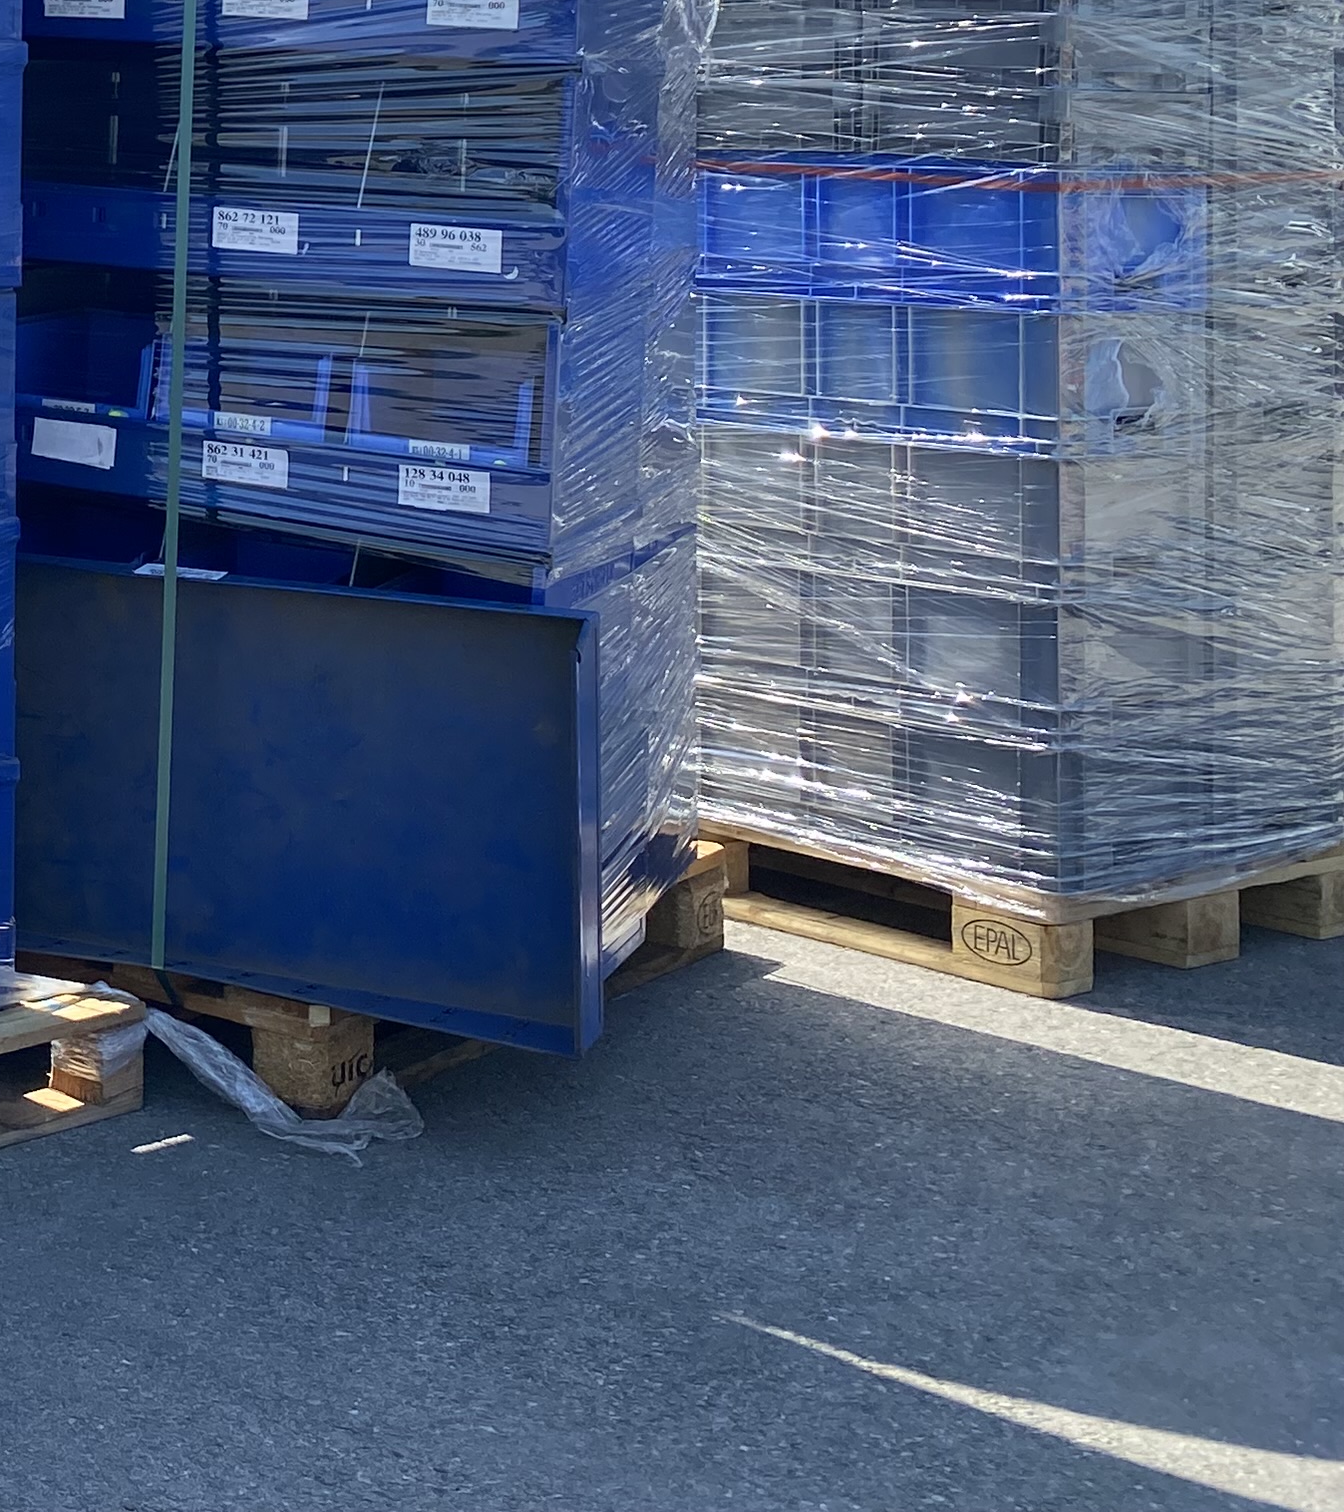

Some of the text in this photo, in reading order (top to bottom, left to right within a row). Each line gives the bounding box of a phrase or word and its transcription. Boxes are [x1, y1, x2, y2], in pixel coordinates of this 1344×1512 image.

[433, 0, 505, 9] 70 000
[217, 210, 280, 226] 862 72 121
[217, 222, 286, 235] 70 000
[415, 227, 482, 242] 489 96 038
[415, 239, 487, 252] 30 562
[207, 443, 268, 461] 862 31 421
[207, 455, 275, 470] 70 000
[404, 468, 470, 484] 128 34 048
[404, 479, 476, 494] 10 000
[973, 924, 1021, 961] EPAL
